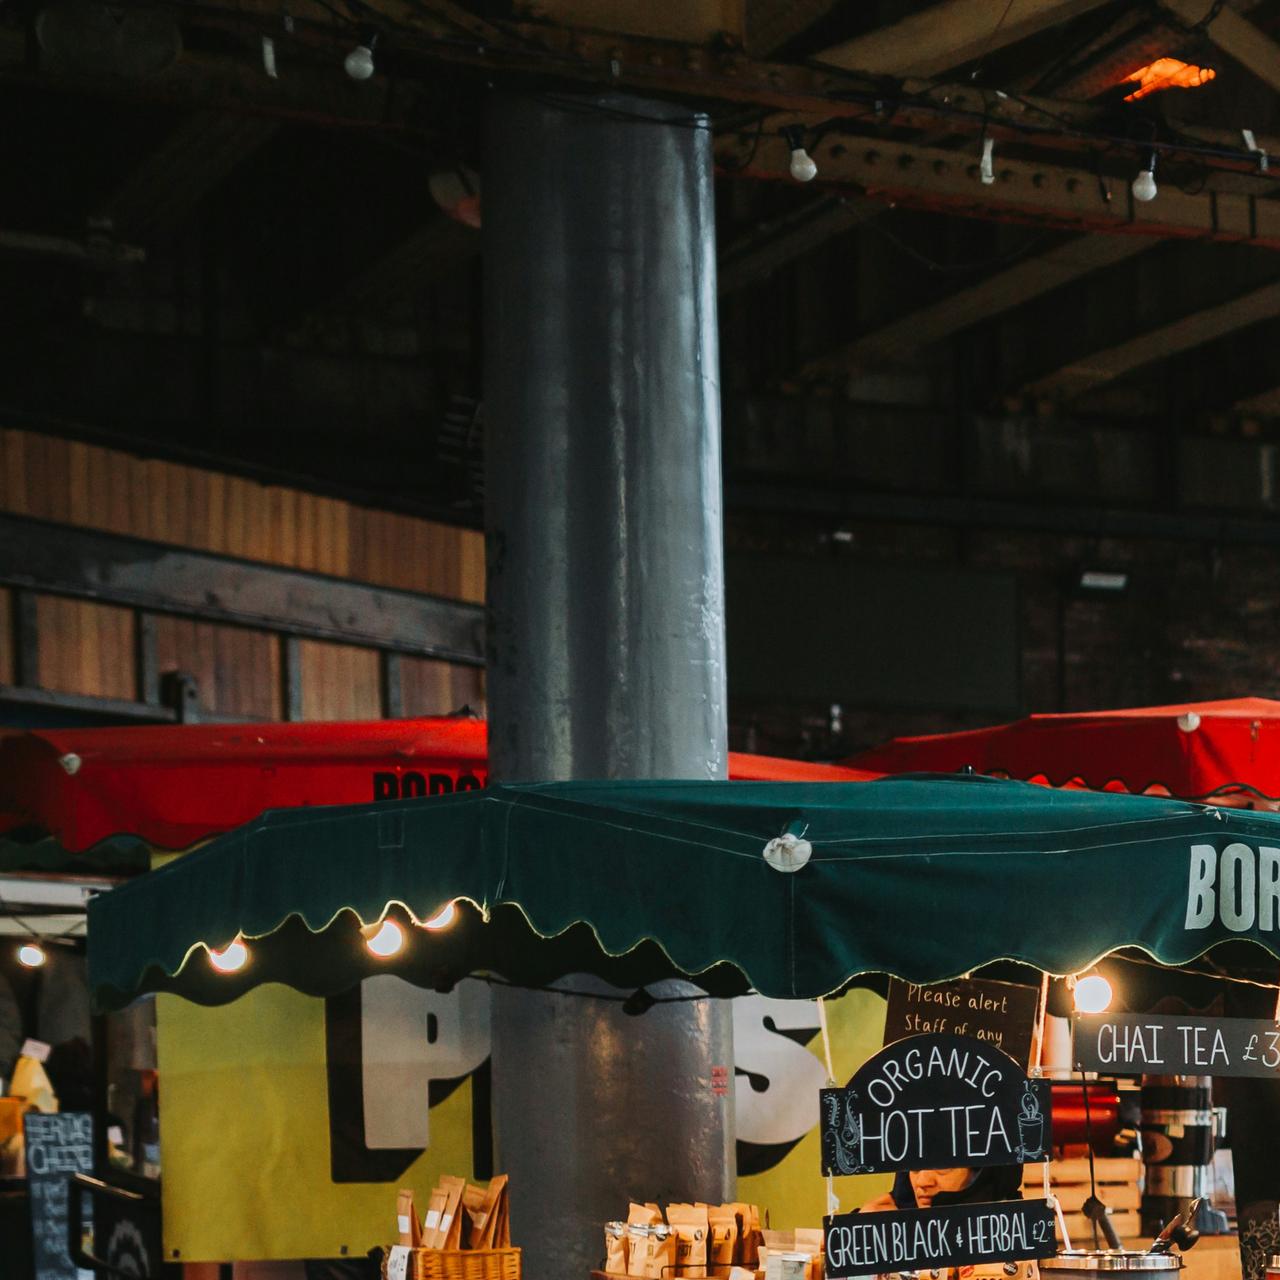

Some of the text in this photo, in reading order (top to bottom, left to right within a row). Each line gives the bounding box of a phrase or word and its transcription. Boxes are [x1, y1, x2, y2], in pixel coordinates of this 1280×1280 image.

[908, 984, 1007, 1013] Please alert
[977, 1028, 1003, 1049] any
[1098, 1024, 1280, 1068] CHAI TEA £3
[868, 1046, 1002, 1107] ORGANIC
[859, 1105, 1012, 1164] HOT TEA
[968, 1213, 1035, 1255] HERBAL
